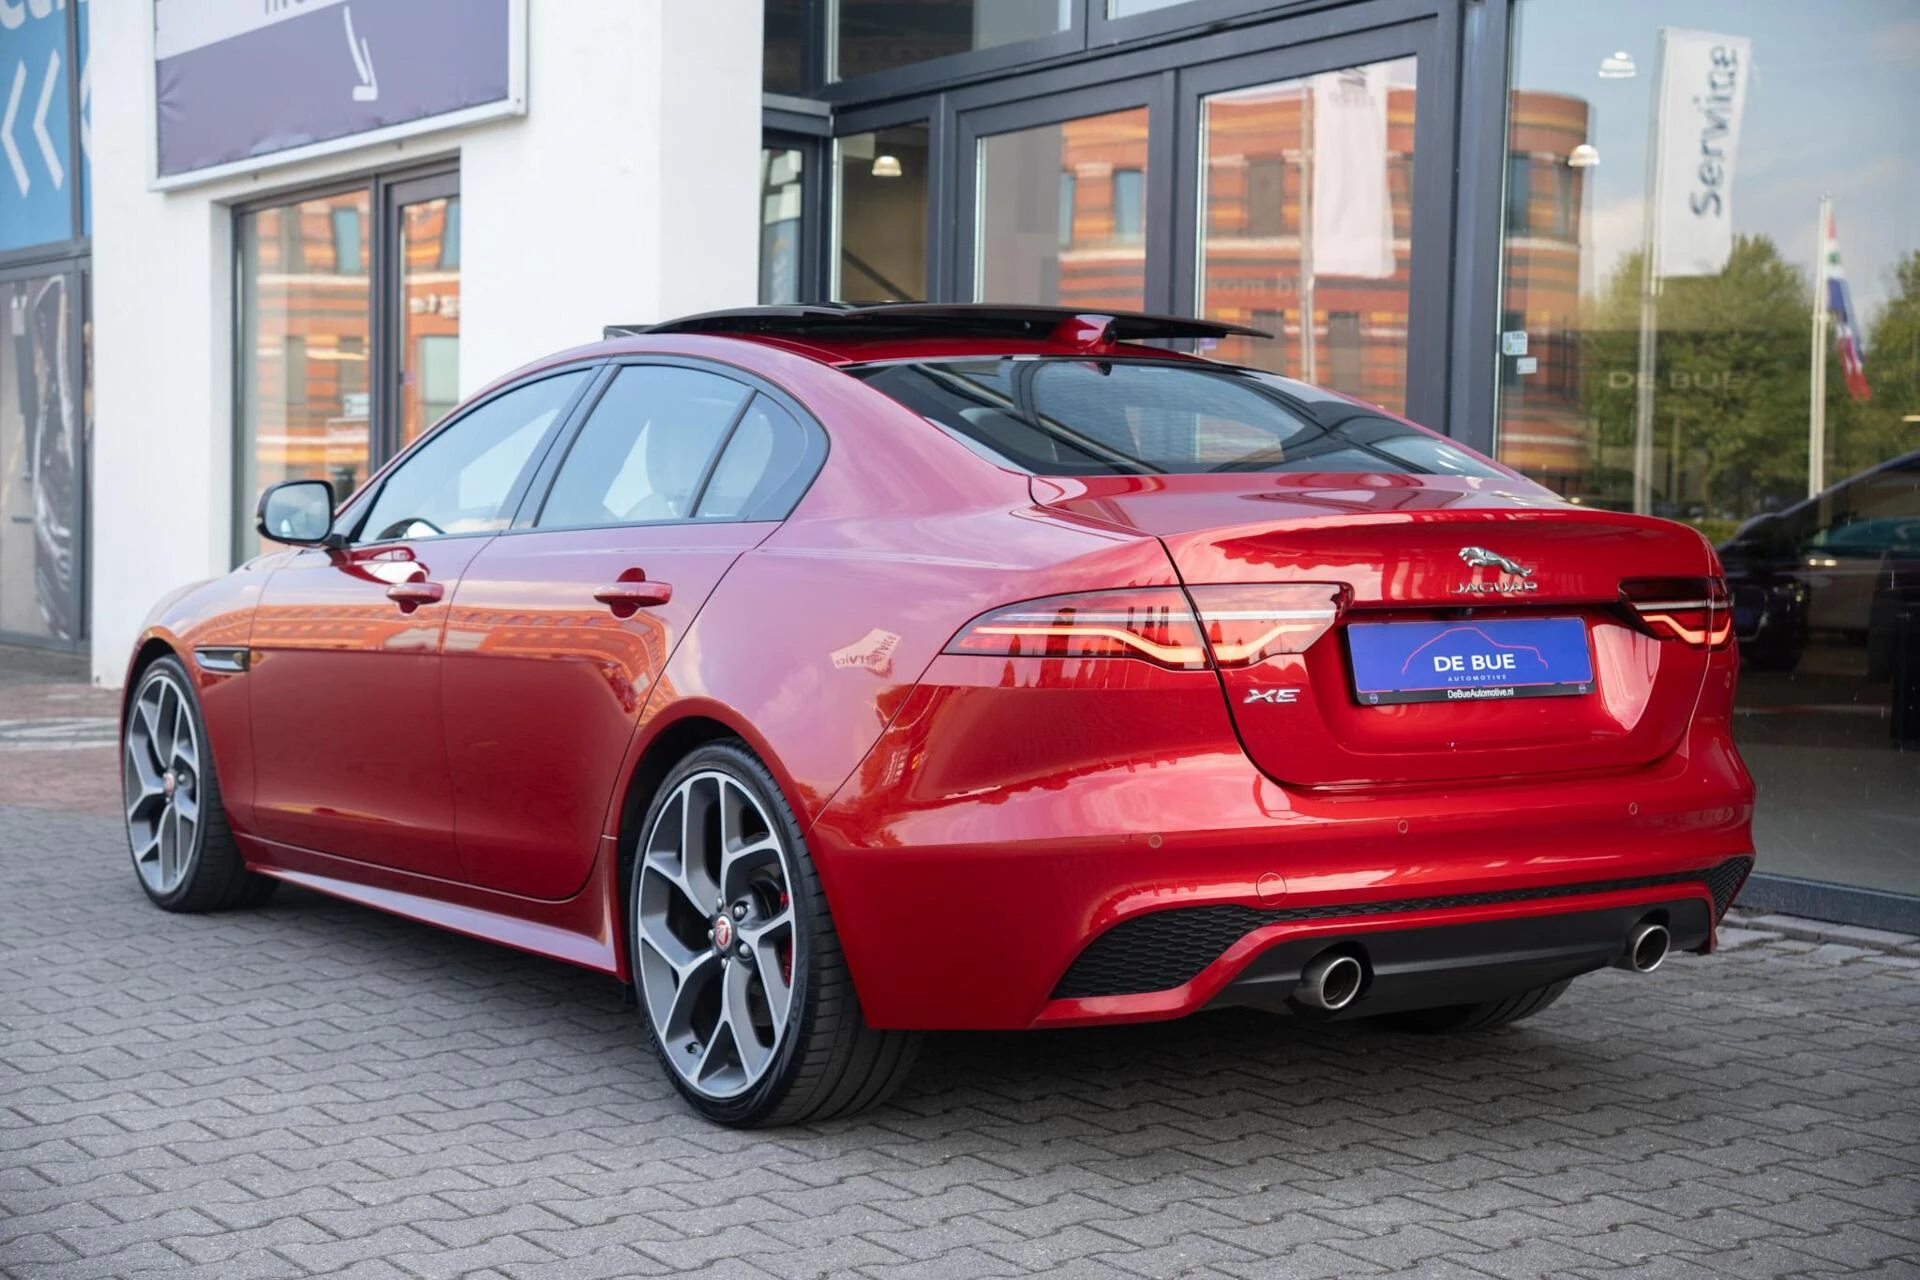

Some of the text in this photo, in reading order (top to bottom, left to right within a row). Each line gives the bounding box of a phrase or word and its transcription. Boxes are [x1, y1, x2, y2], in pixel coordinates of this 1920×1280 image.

[1689, 45, 1738, 218] Service
[1451, 581, 1538, 593] JAGUAR
[1433, 653, 1516, 672] DE BUE
[1447, 674, 1507, 682] AUTOMOTIVE
[1243, 688, 1301, 703] XE
[1447, 687, 1515, 699] DeBueAutomotive.nl
